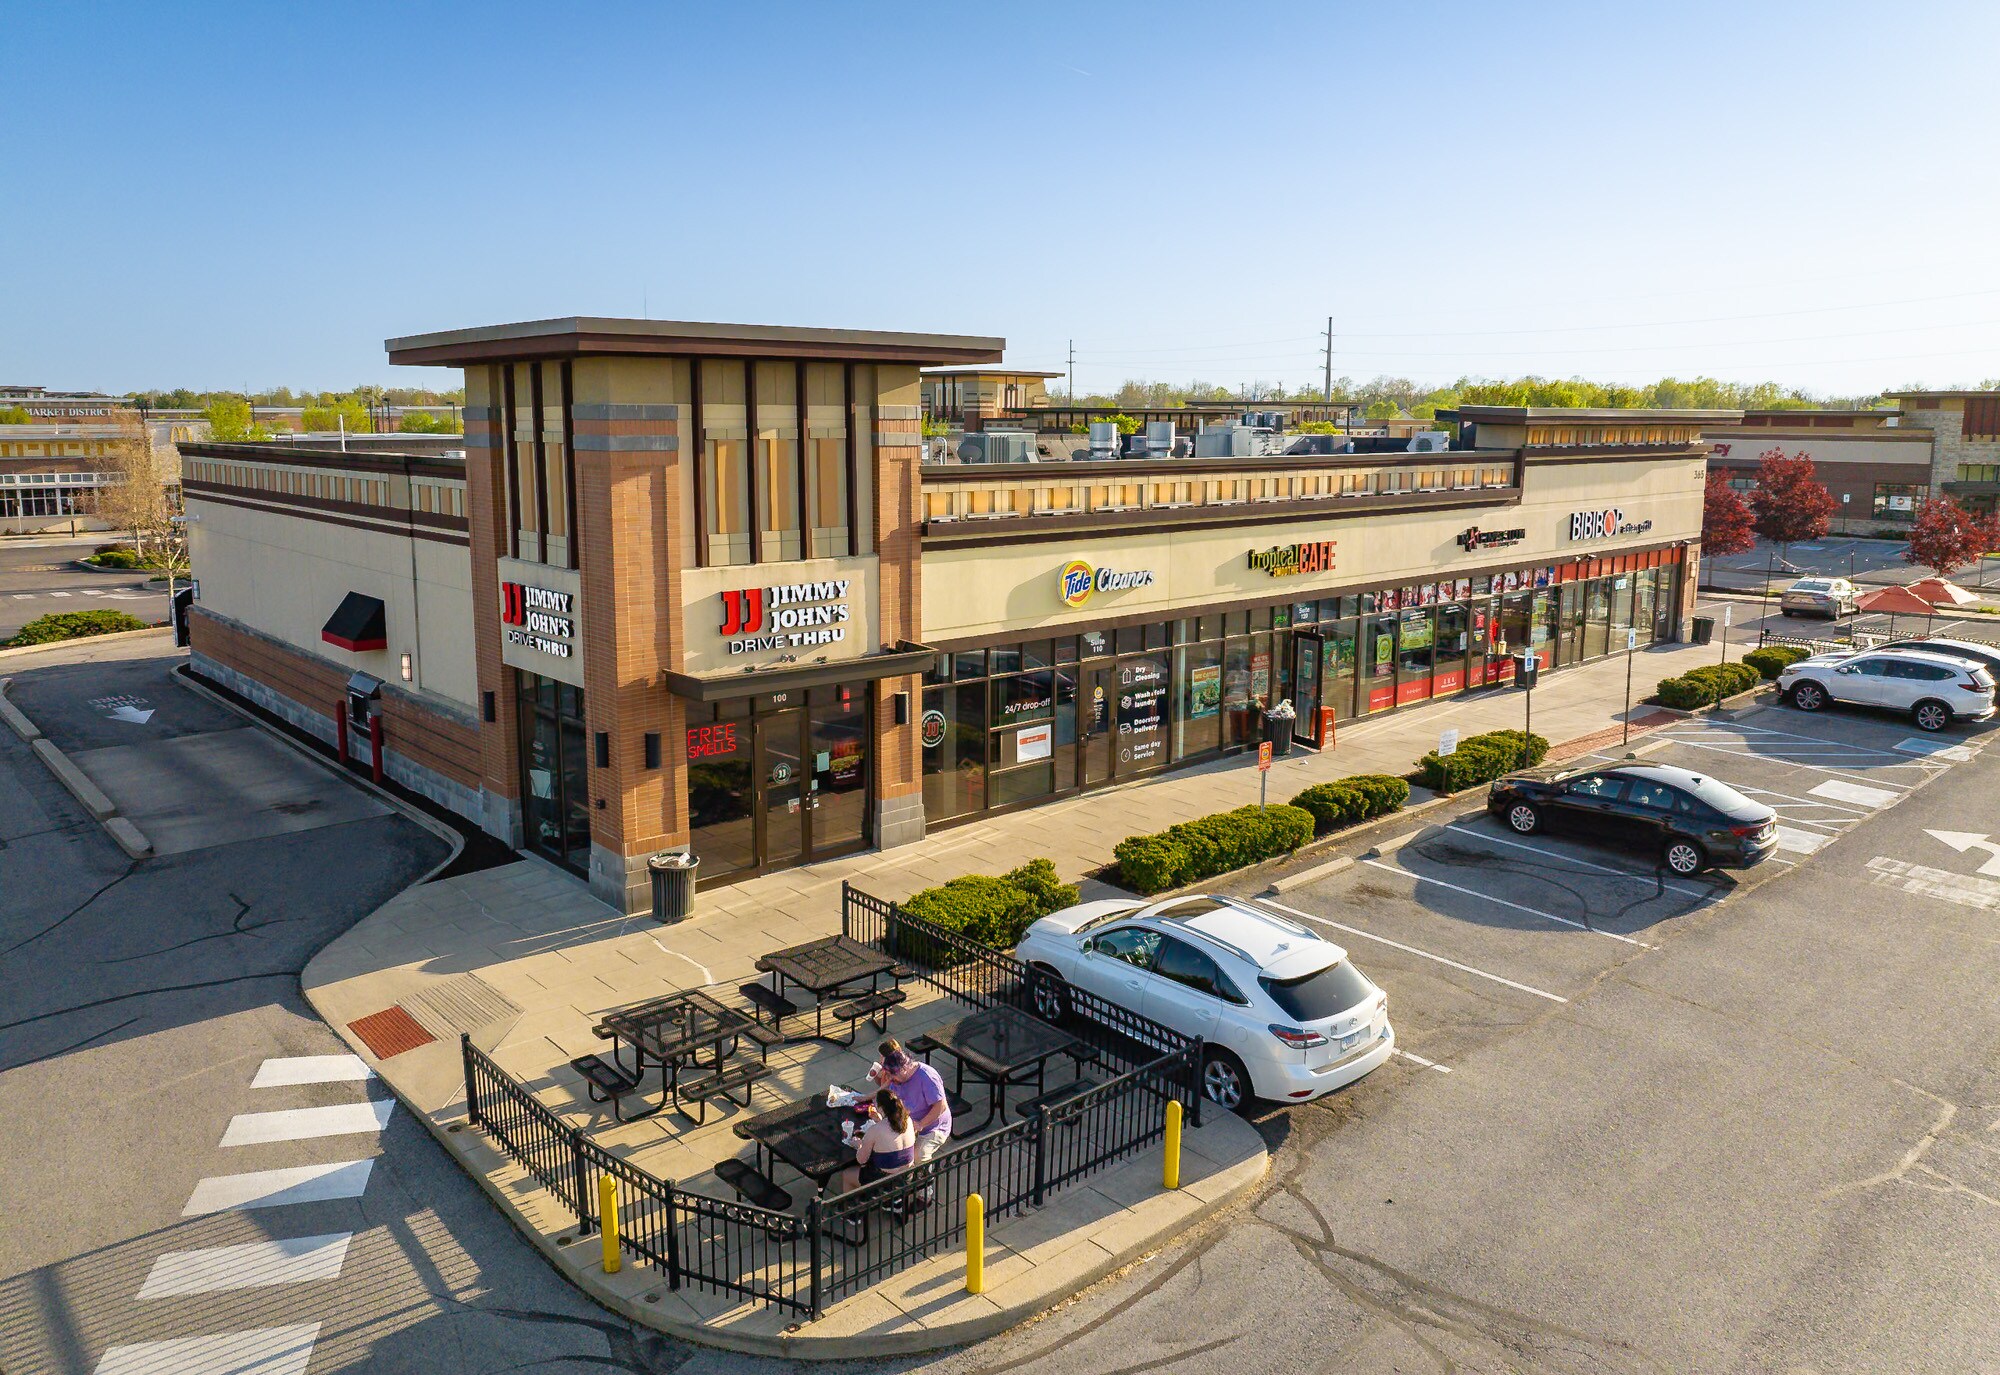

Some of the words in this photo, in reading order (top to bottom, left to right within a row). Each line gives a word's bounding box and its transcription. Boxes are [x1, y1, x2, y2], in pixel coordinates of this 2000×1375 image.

[25, 408, 66, 417] MARKET
[69, 407, 112, 417] DISTRICT
[1572, 508, 1624, 541] BIBIBOP
[1250, 544, 1299, 573] tropical
[1300, 541, 1337, 574] CAFE
[1064, 570, 1092, 600] Tide
[1097, 568, 1154, 592] Cleaners
[502, 582, 522, 626] JJ
[525, 586, 569, 613] JIMMY
[770, 580, 850, 609] JIMMY
[720, 588, 762, 636] JJ
[771, 604, 850, 633] JOHN'S
[525, 611, 570, 638] JOHN'S
[507, 630, 535, 649] DRIVE
[535, 637, 568, 658] THRU
[731, 636, 785, 655] DRIVE
[788, 628, 846, 647] THRU
[1135, 666, 1146, 674] Dry
[1135, 672, 1160, 682] Cleaning
[772, 693, 787, 703] 100
[1004, 703, 1021, 714] 24/7
[1022, 698, 1051, 712] drop-off
[1134, 698, 1157, 709] laundry
[1135, 691, 1150, 699] Wash
[1134, 715, 1160, 726] Doorstep
[1134, 724, 1158, 735] Delivery
[688, 723, 737, 747] FREE
[1134, 743, 1150, 752] Same
[1151, 740, 1161, 749] day
[688, 736, 737, 759] SMELLS
[1134, 750, 1155, 761] Service
